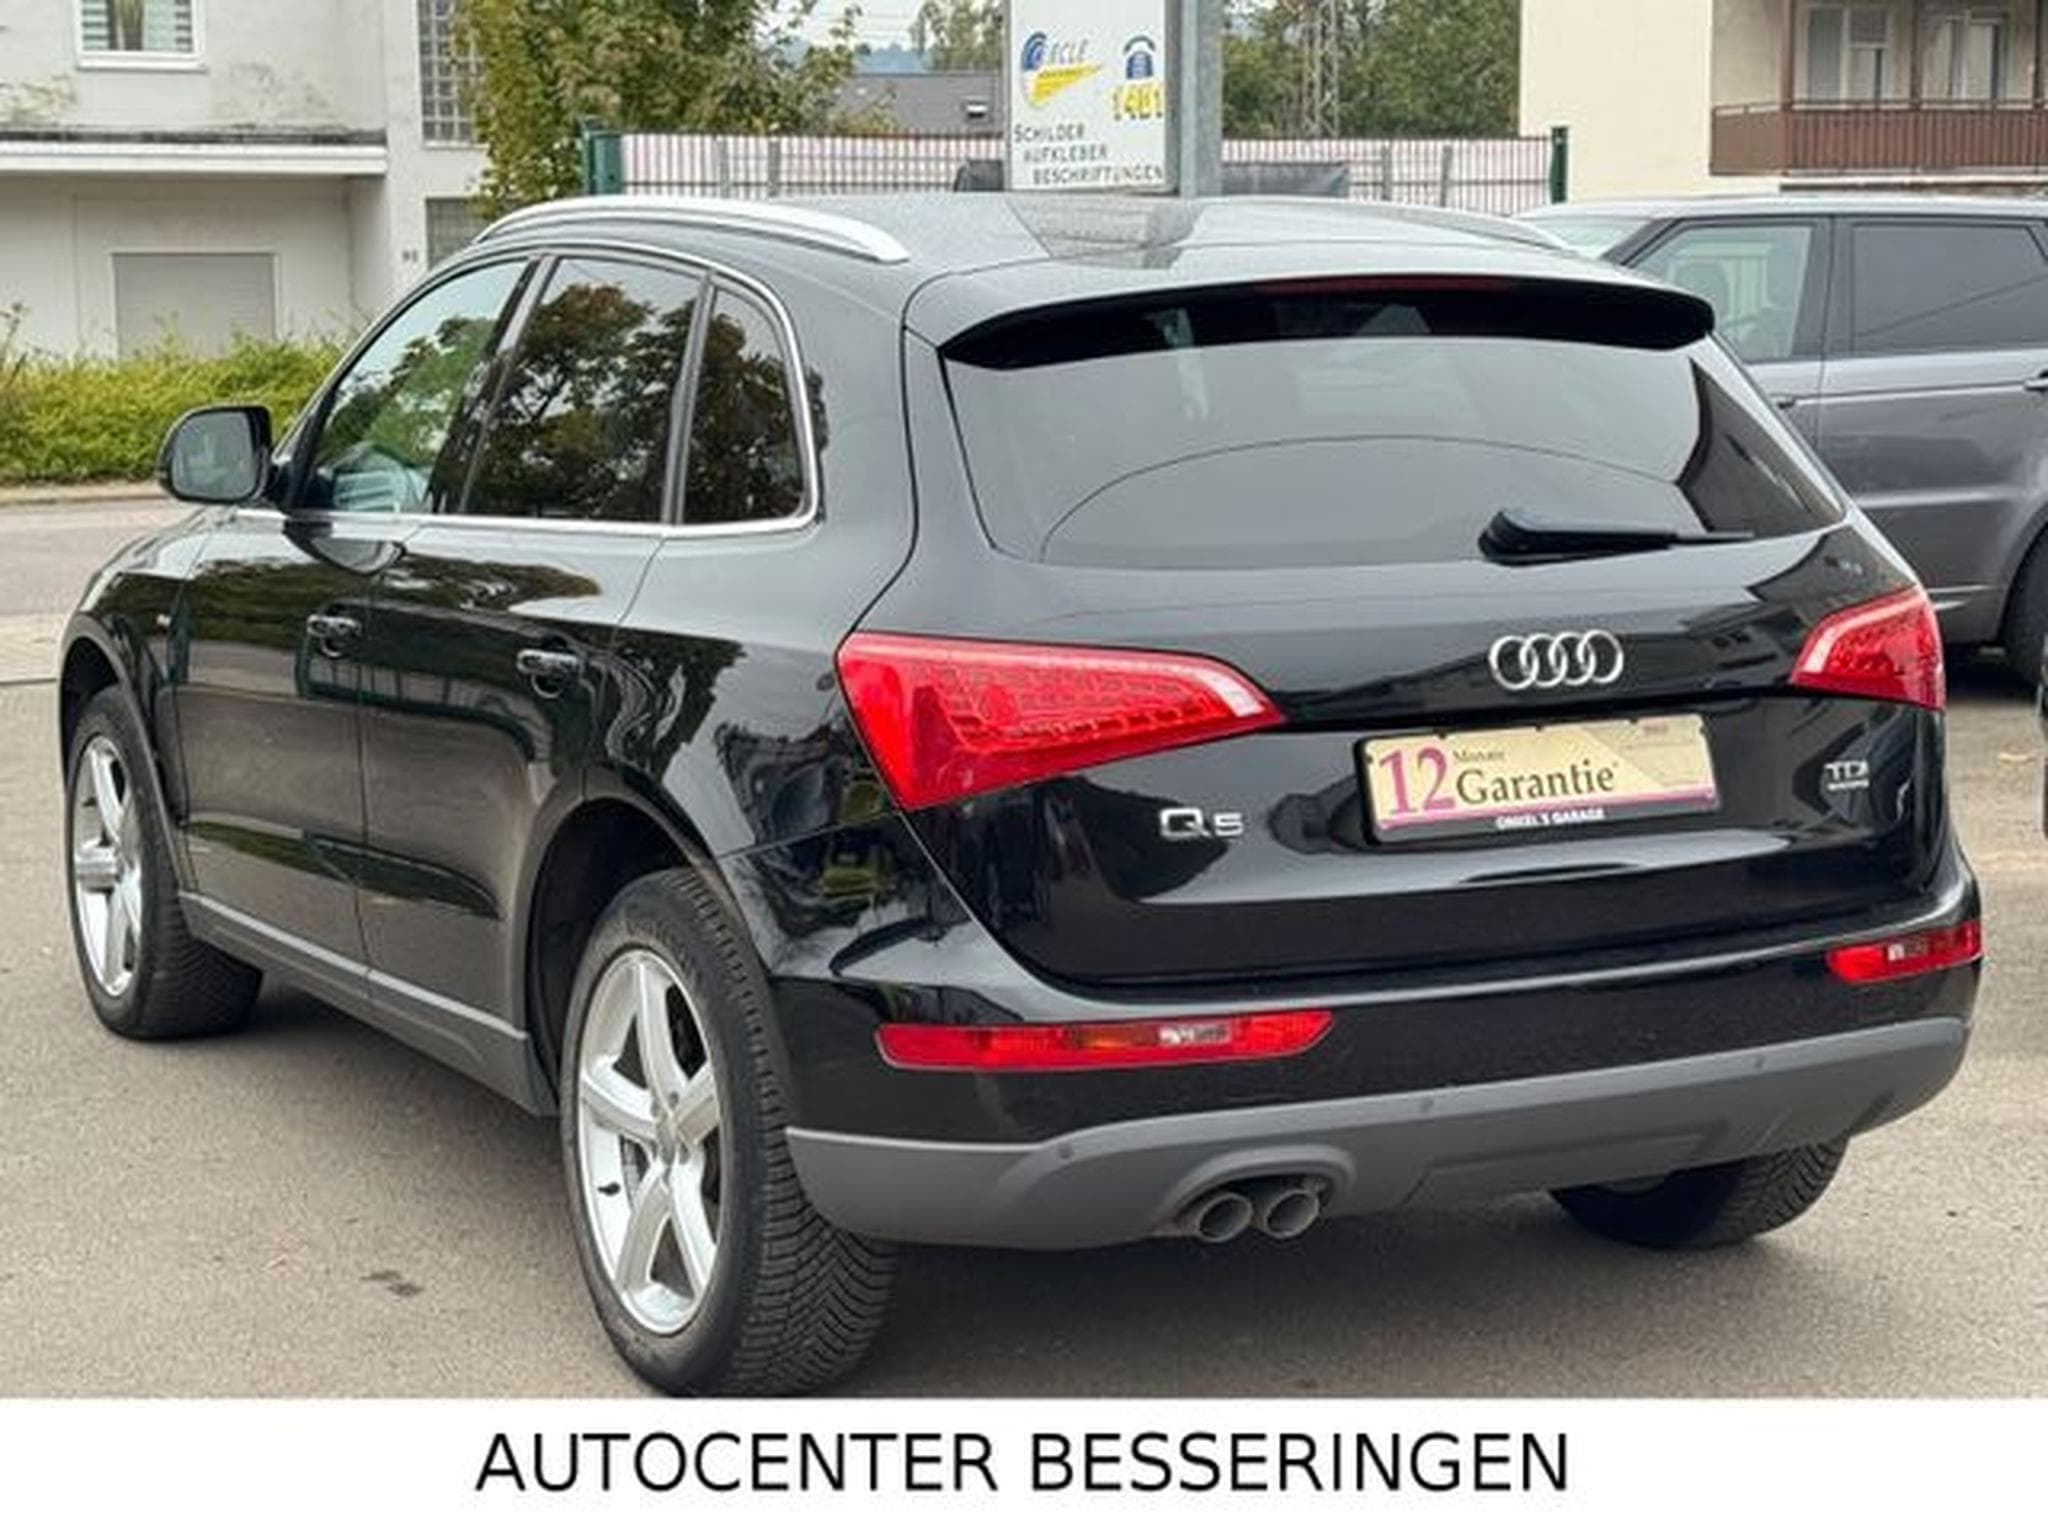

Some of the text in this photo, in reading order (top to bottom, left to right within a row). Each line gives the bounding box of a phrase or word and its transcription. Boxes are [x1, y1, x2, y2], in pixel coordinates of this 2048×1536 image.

[1014, 123, 1085, 143] SCHILDER
[1023, 143, 1107, 163] AUFKLEBER
[1033, 165, 1164, 185] BESCHRIFTUNGEN
[1379, 746, 1456, 815] 12
[1455, 758, 1616, 806] Garantie
[1160, 807, 1244, 839] Q5
